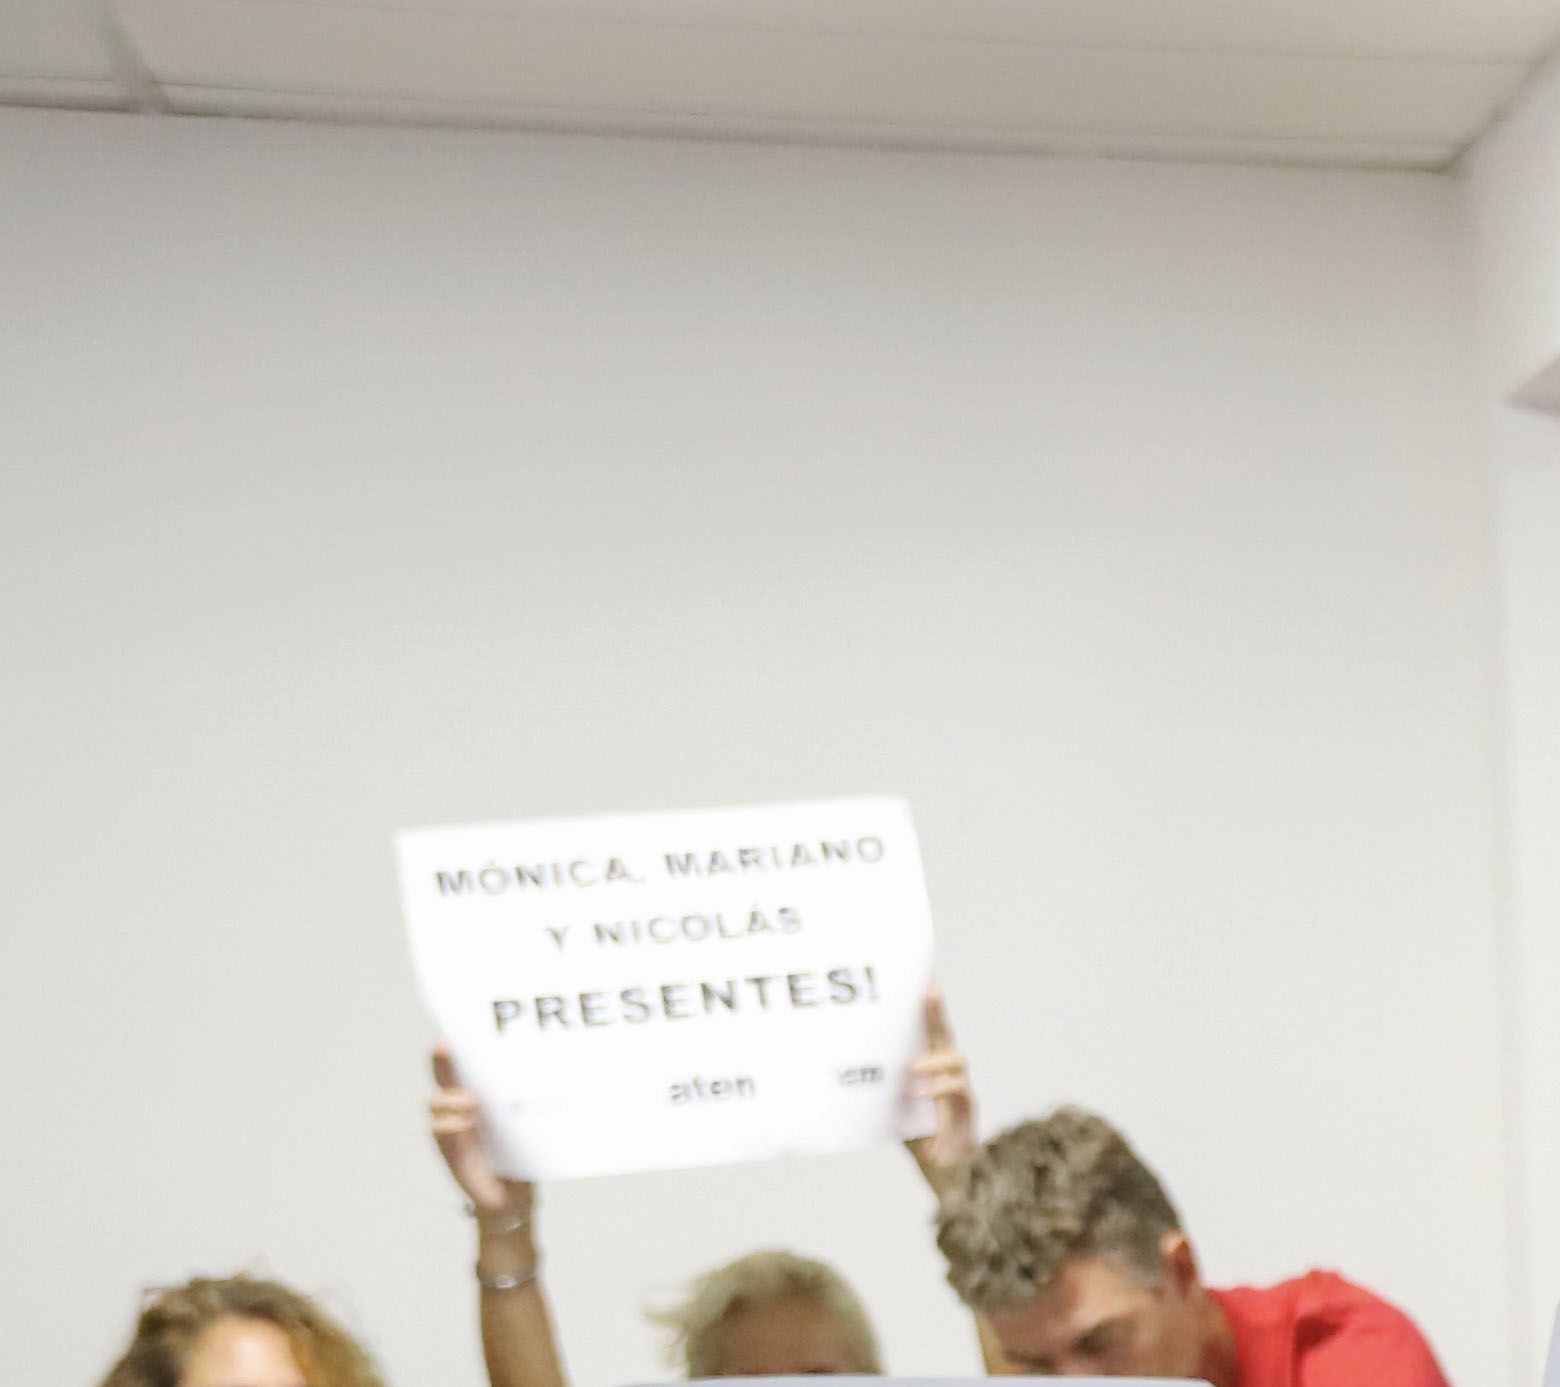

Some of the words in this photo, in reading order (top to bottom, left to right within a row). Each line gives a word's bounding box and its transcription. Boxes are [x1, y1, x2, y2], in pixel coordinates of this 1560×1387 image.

[664, 837, 884, 876] MARIANO
[545, 927, 568, 949] Y
[593, 907, 801, 945] NICOLÁS
[491, 966, 877, 1034] PRESENTES!
[668, 1068, 755, 1104] aten
